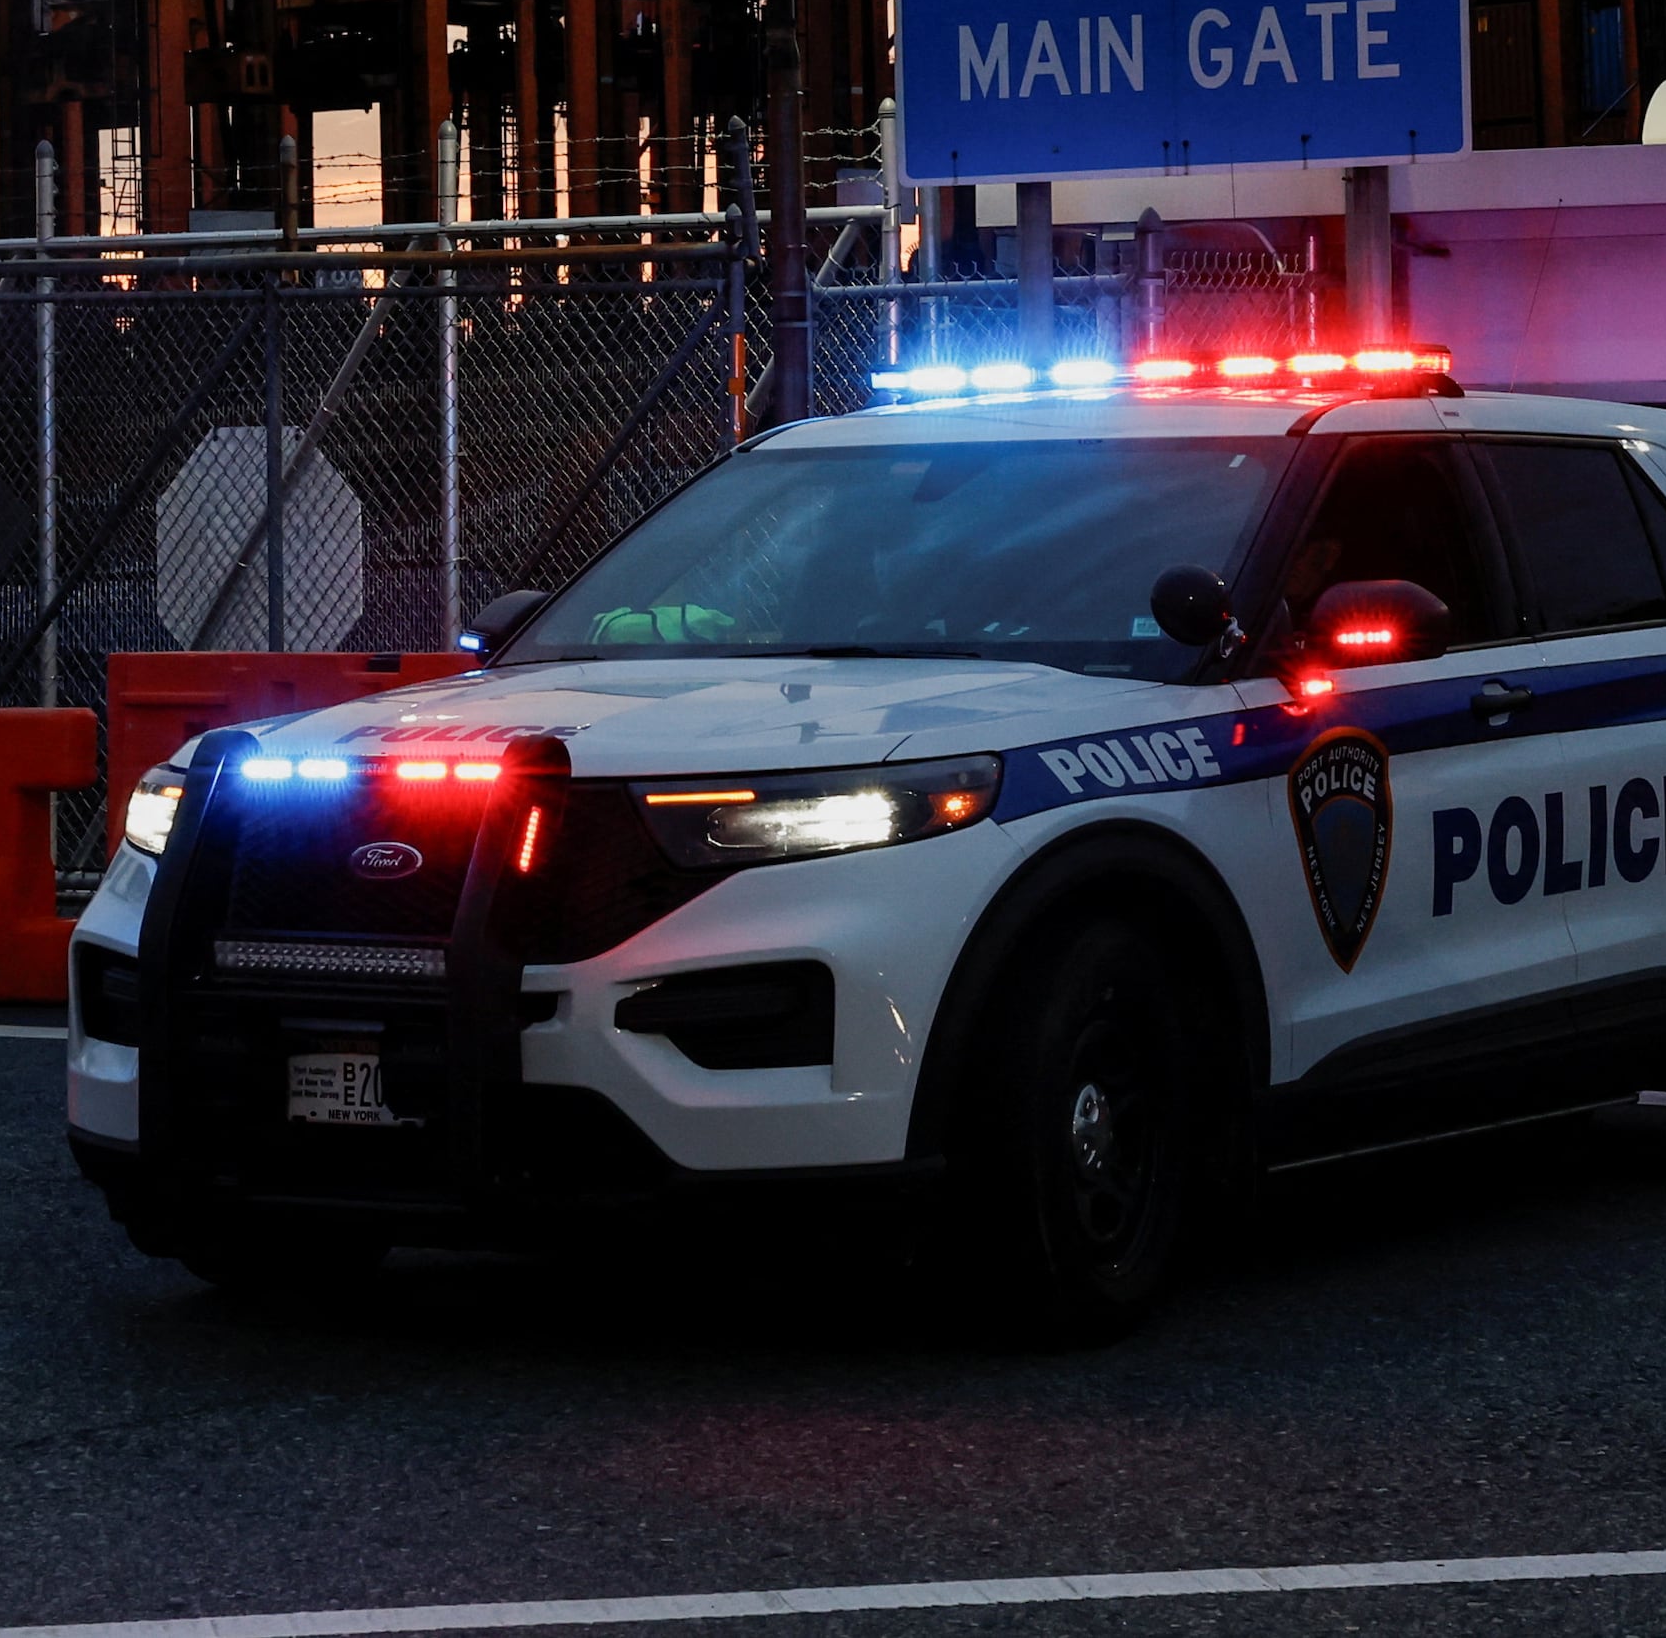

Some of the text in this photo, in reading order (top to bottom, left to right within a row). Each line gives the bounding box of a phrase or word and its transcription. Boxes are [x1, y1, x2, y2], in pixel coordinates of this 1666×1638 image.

[958, 14, 1145, 102] MAIN
[334, 725, 583, 745] POLICE
[1037, 727, 1222, 795] POLICE
[1297, 746, 1380, 787] PORT AUTHORITY
[1300, 763, 1377, 815] POLICE
[361, 849, 404, 868] Ford
[1306, 844, 1326, 888] NEW
[1356, 819, 1387, 934] NEW JERSEY
[328, 1109, 381, 1122] NEW YORK
